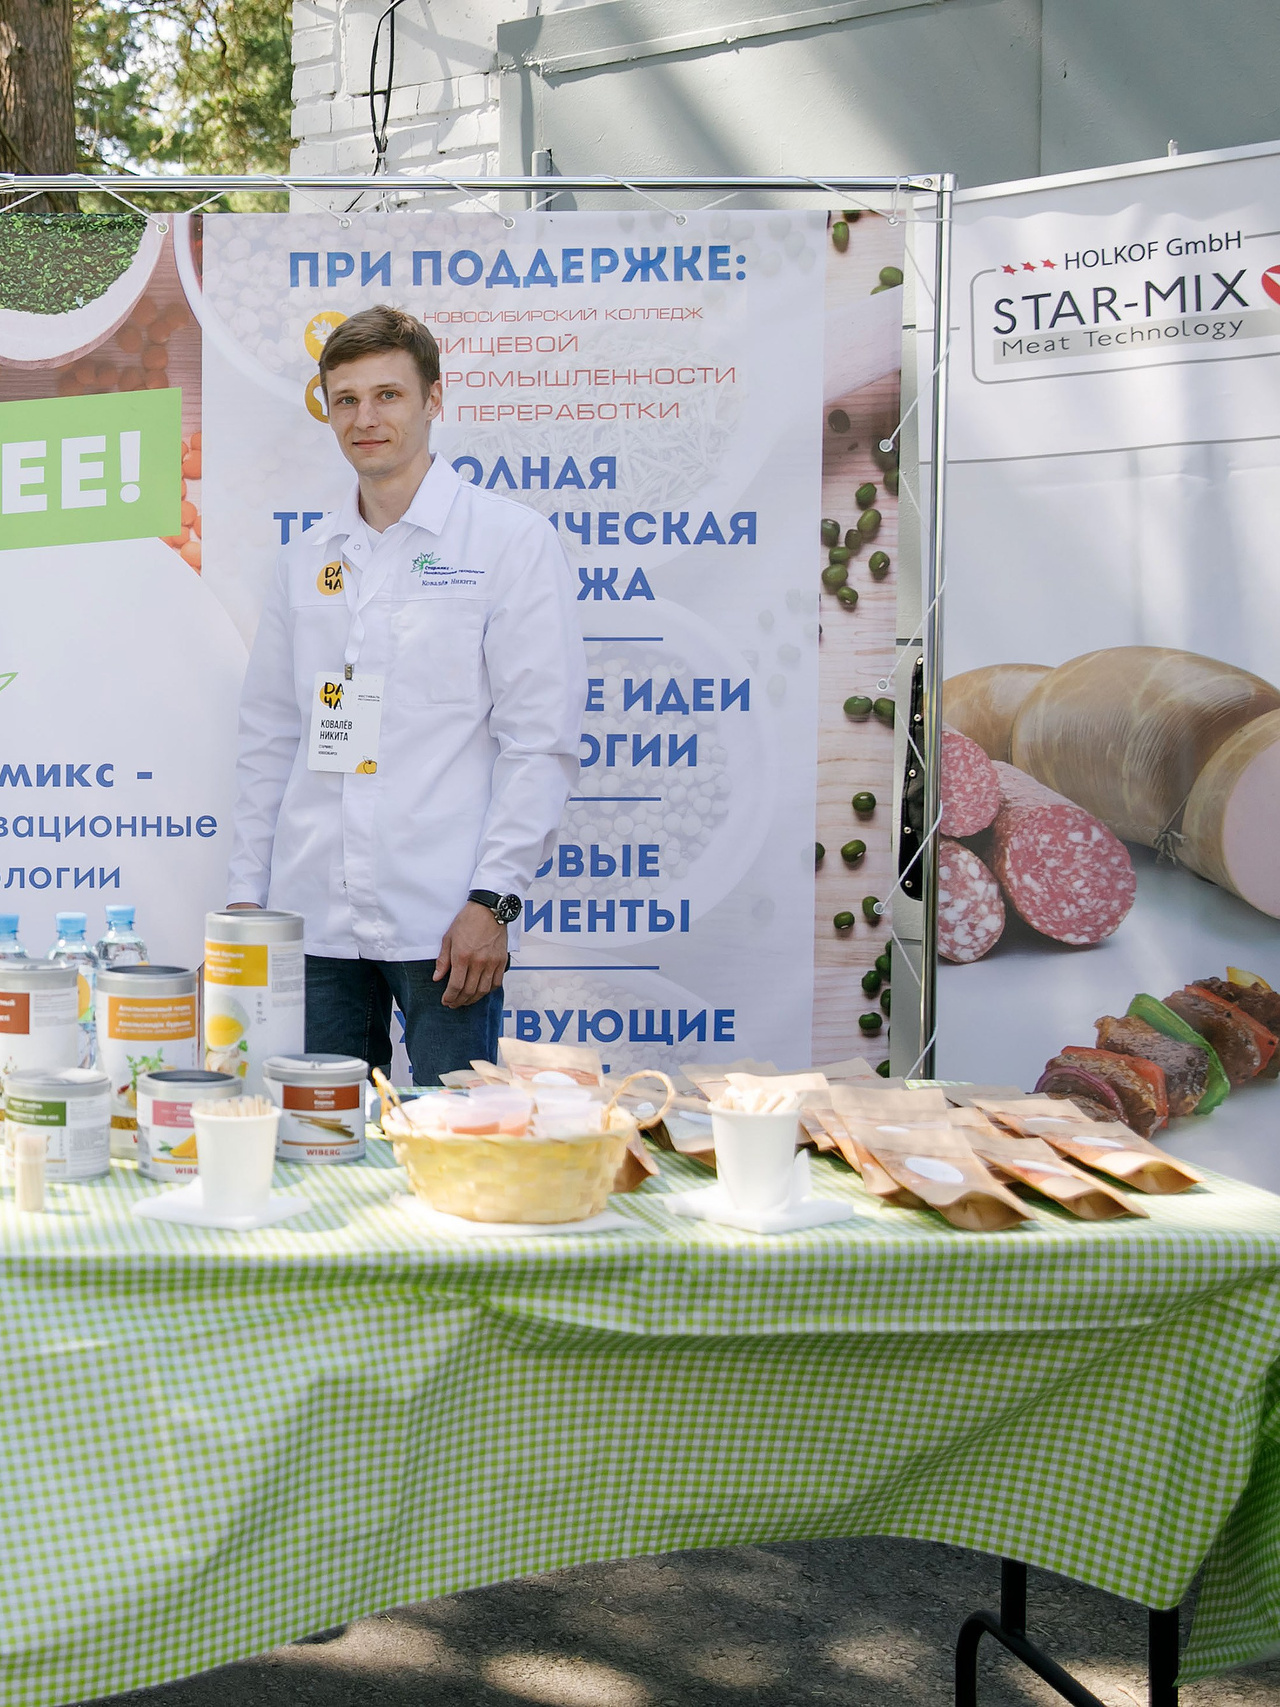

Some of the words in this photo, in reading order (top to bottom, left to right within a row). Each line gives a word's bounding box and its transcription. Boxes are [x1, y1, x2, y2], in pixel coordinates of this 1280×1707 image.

[1064, 241, 1159, 271] HOLKOF
[1166, 230, 1242, 257] GmbH
[289, 251, 391, 288] ПРИ
[412, 245, 747, 289] ПОДДЕРЖКЕ:
[992, 268, 1250, 335] STAR-MIX
[423, 307, 597, 323] НОВОСИБИРСКИЙ
[605, 307, 704, 322] КОЛЛЕДЖ
[1002, 336, 1070, 357] Meat
[1083, 319, 1244, 347] Technology
[439, 367, 737, 389] РОМЫШЛЕННОСТИ
[457, 402, 680, 422] ПЕРЕРАБОТКИ
[451, 455, 617, 490] ОЛНАЯ
[623, 678, 750, 715] ИДЕИ
[320, 719, 353, 730] КОВАЛЁВ
[320, 731, 349, 741] НИКИТА
[137, 771, 153, 780] -
[175, 1167, 198, 1175] WIBE
